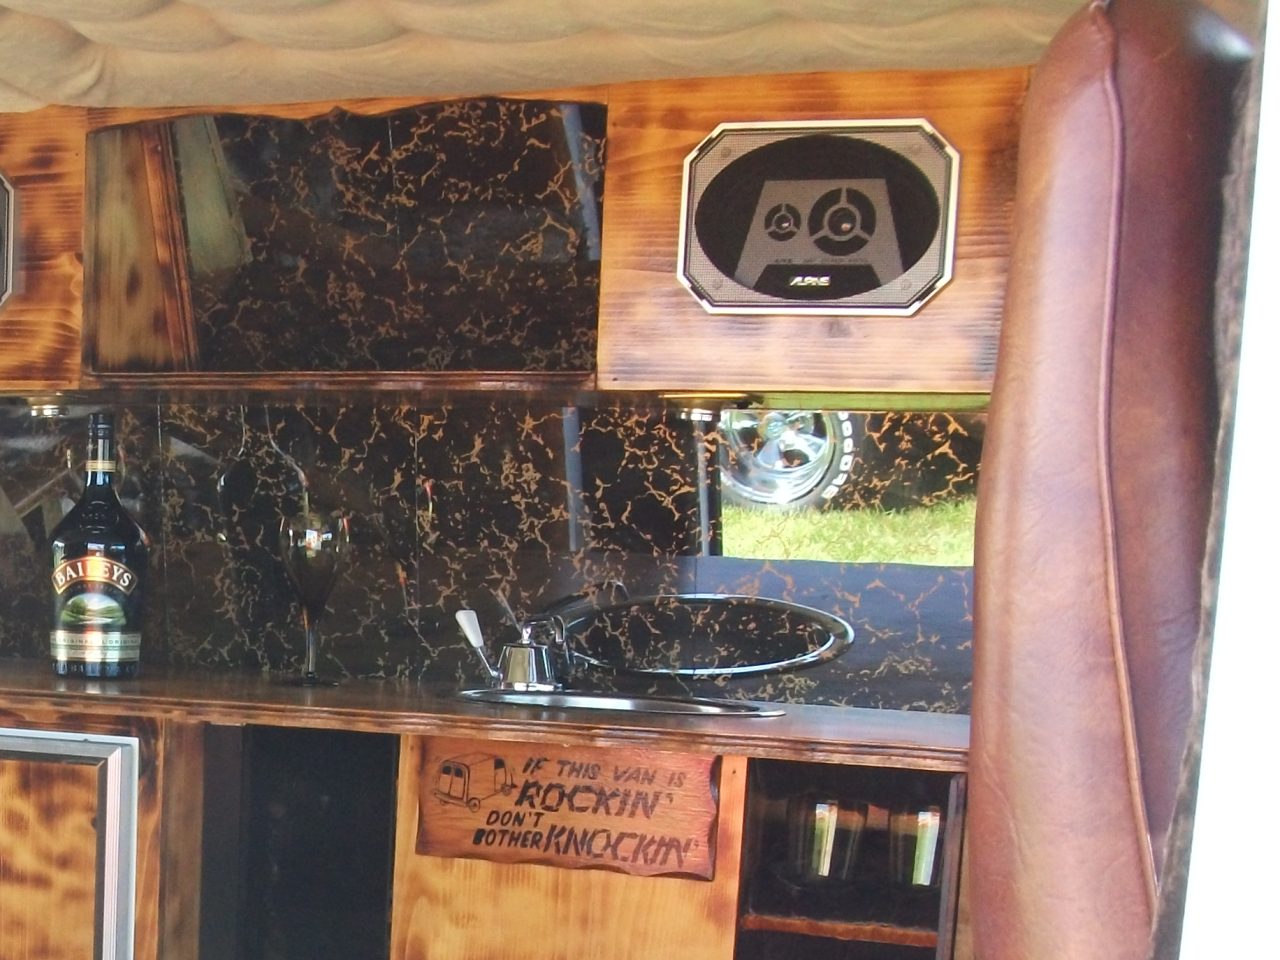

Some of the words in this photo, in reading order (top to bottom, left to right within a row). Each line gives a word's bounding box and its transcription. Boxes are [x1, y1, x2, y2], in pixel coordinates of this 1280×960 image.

[55, 561, 132, 587] BAIEYS
[522, 757, 550, 774] IF
[557, 759, 602, 781] THIS
[613, 766, 657, 786] VAN
[668, 771, 688, 789] IS
[486, 810, 545, 828] DON'T
[472, 828, 544, 851] BOTHER
